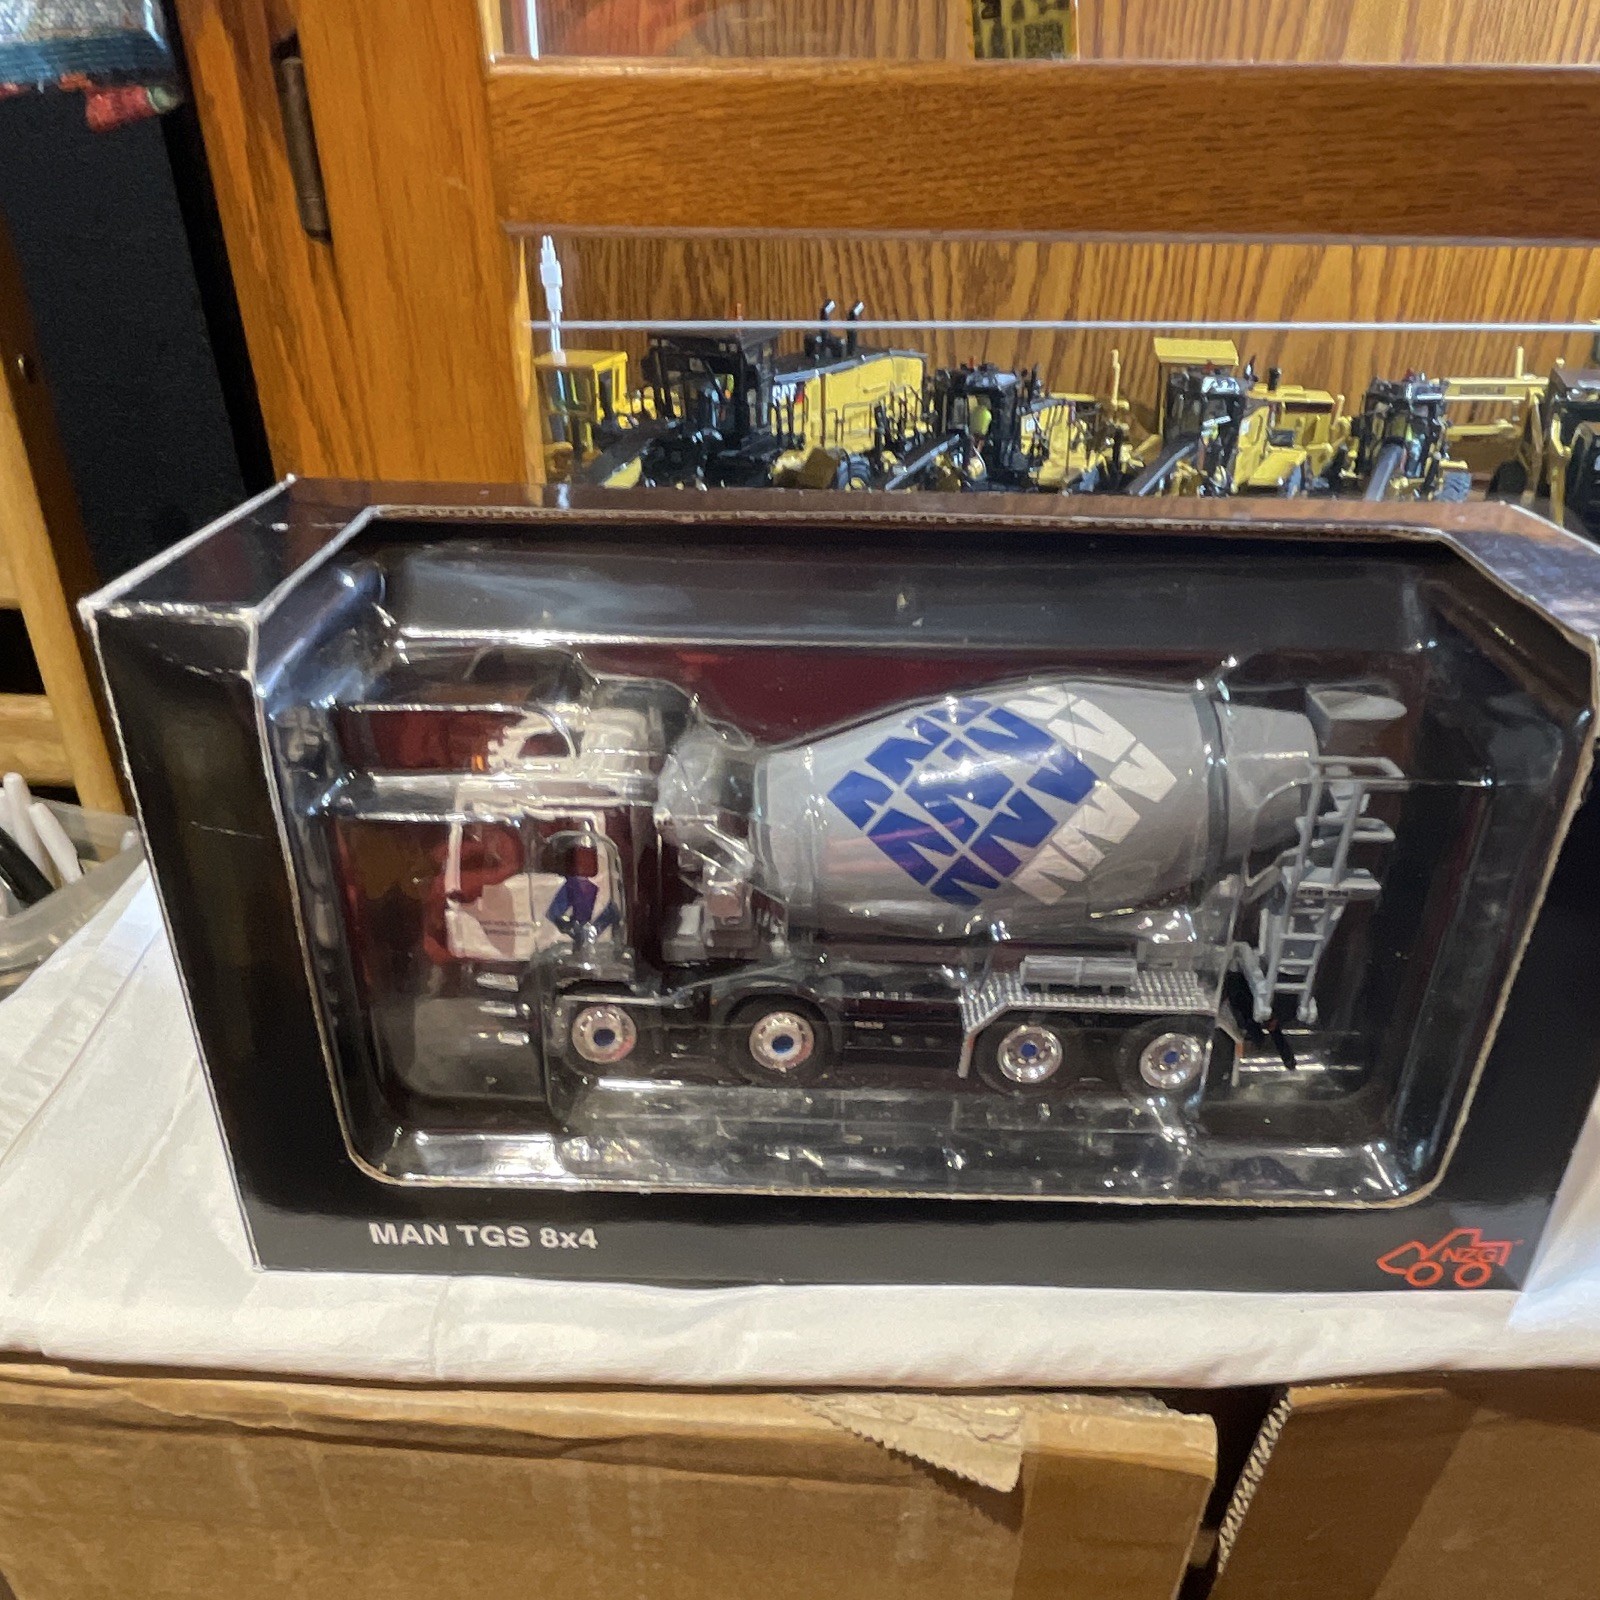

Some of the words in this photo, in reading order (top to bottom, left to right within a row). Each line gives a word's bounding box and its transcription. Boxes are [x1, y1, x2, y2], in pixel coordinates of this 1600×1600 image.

[368, 1222, 449, 1246] MAN
[456, 1225, 530, 1249] TGS
[539, 1227, 598, 1249] 8x4
